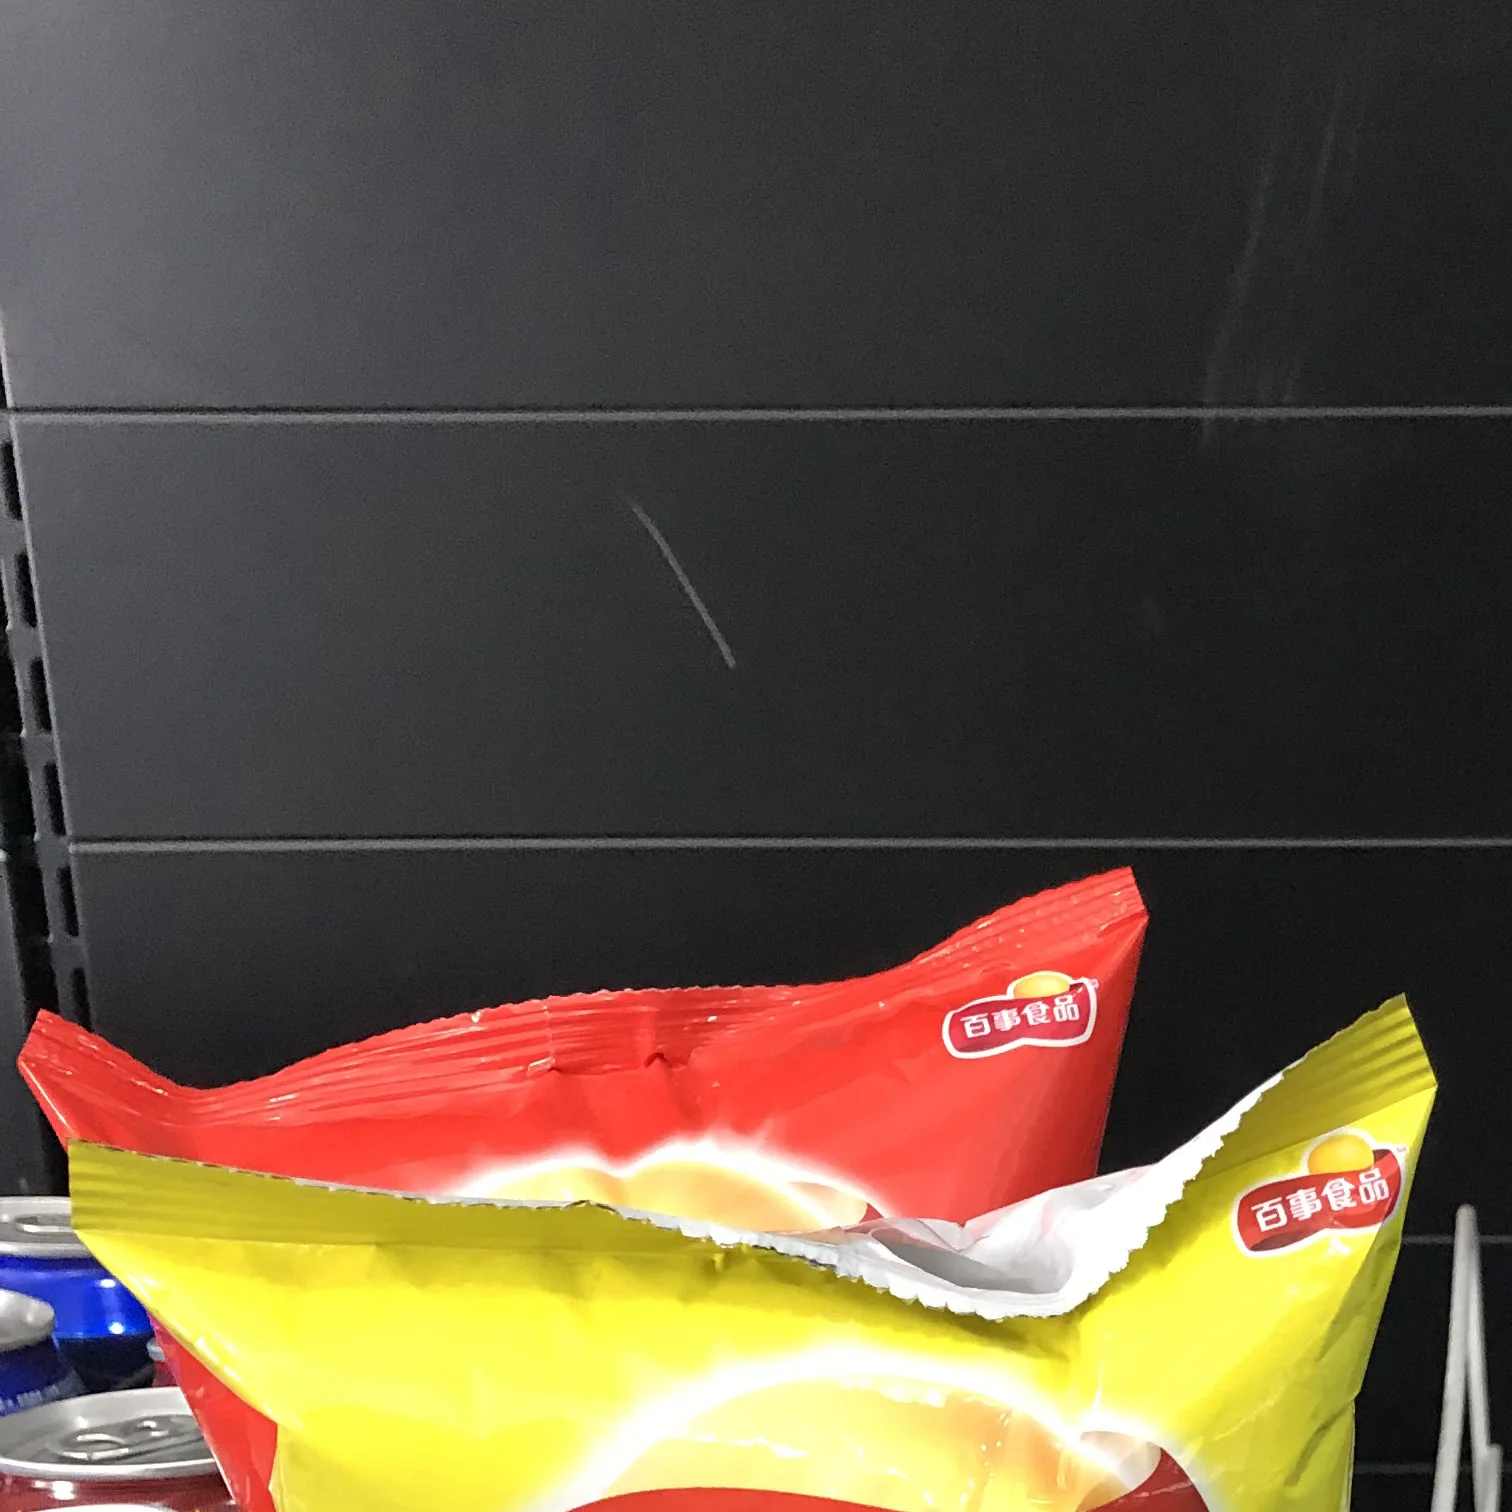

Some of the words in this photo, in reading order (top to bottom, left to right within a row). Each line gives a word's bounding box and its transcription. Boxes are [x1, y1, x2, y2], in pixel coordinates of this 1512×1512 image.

[960, 994, 1081, 1039] 百事食品
[1250, 1165, 1391, 1233] 百事食品
